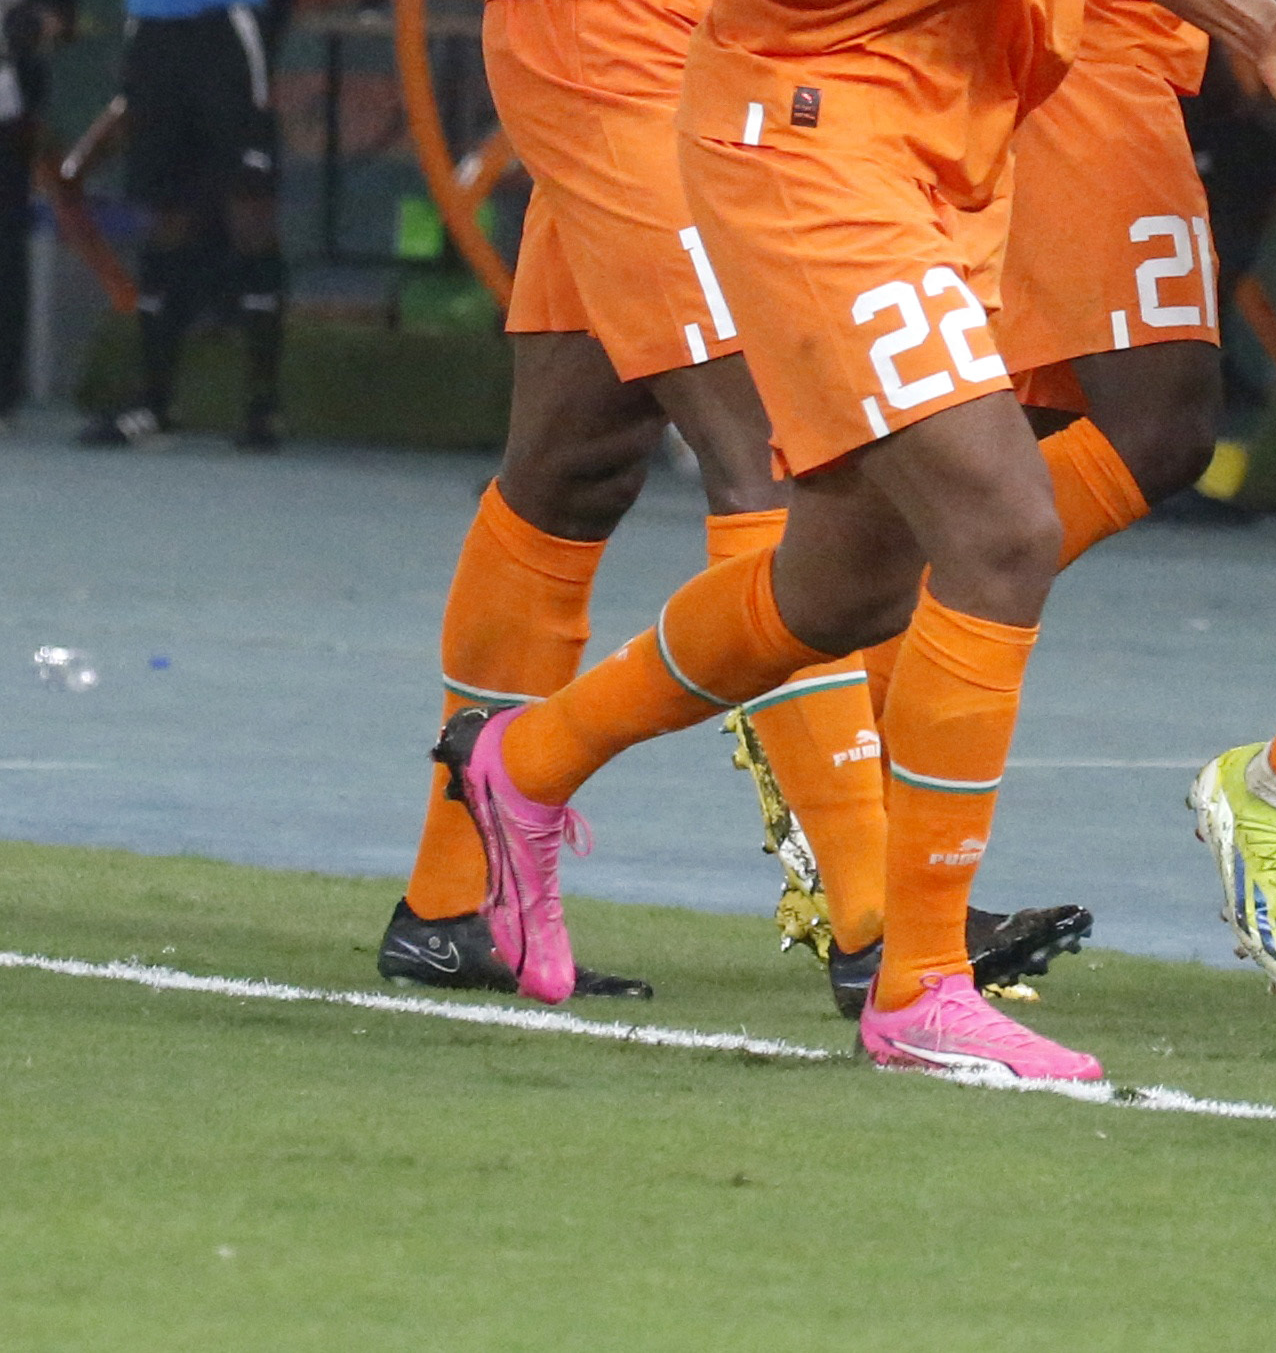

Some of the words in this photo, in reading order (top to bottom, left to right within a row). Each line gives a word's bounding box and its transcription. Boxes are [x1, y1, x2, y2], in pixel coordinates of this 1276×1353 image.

[1129, 215, 1216, 328] 21
[851, 265, 1008, 410] 22
[832, 744, 881, 767] PUM
